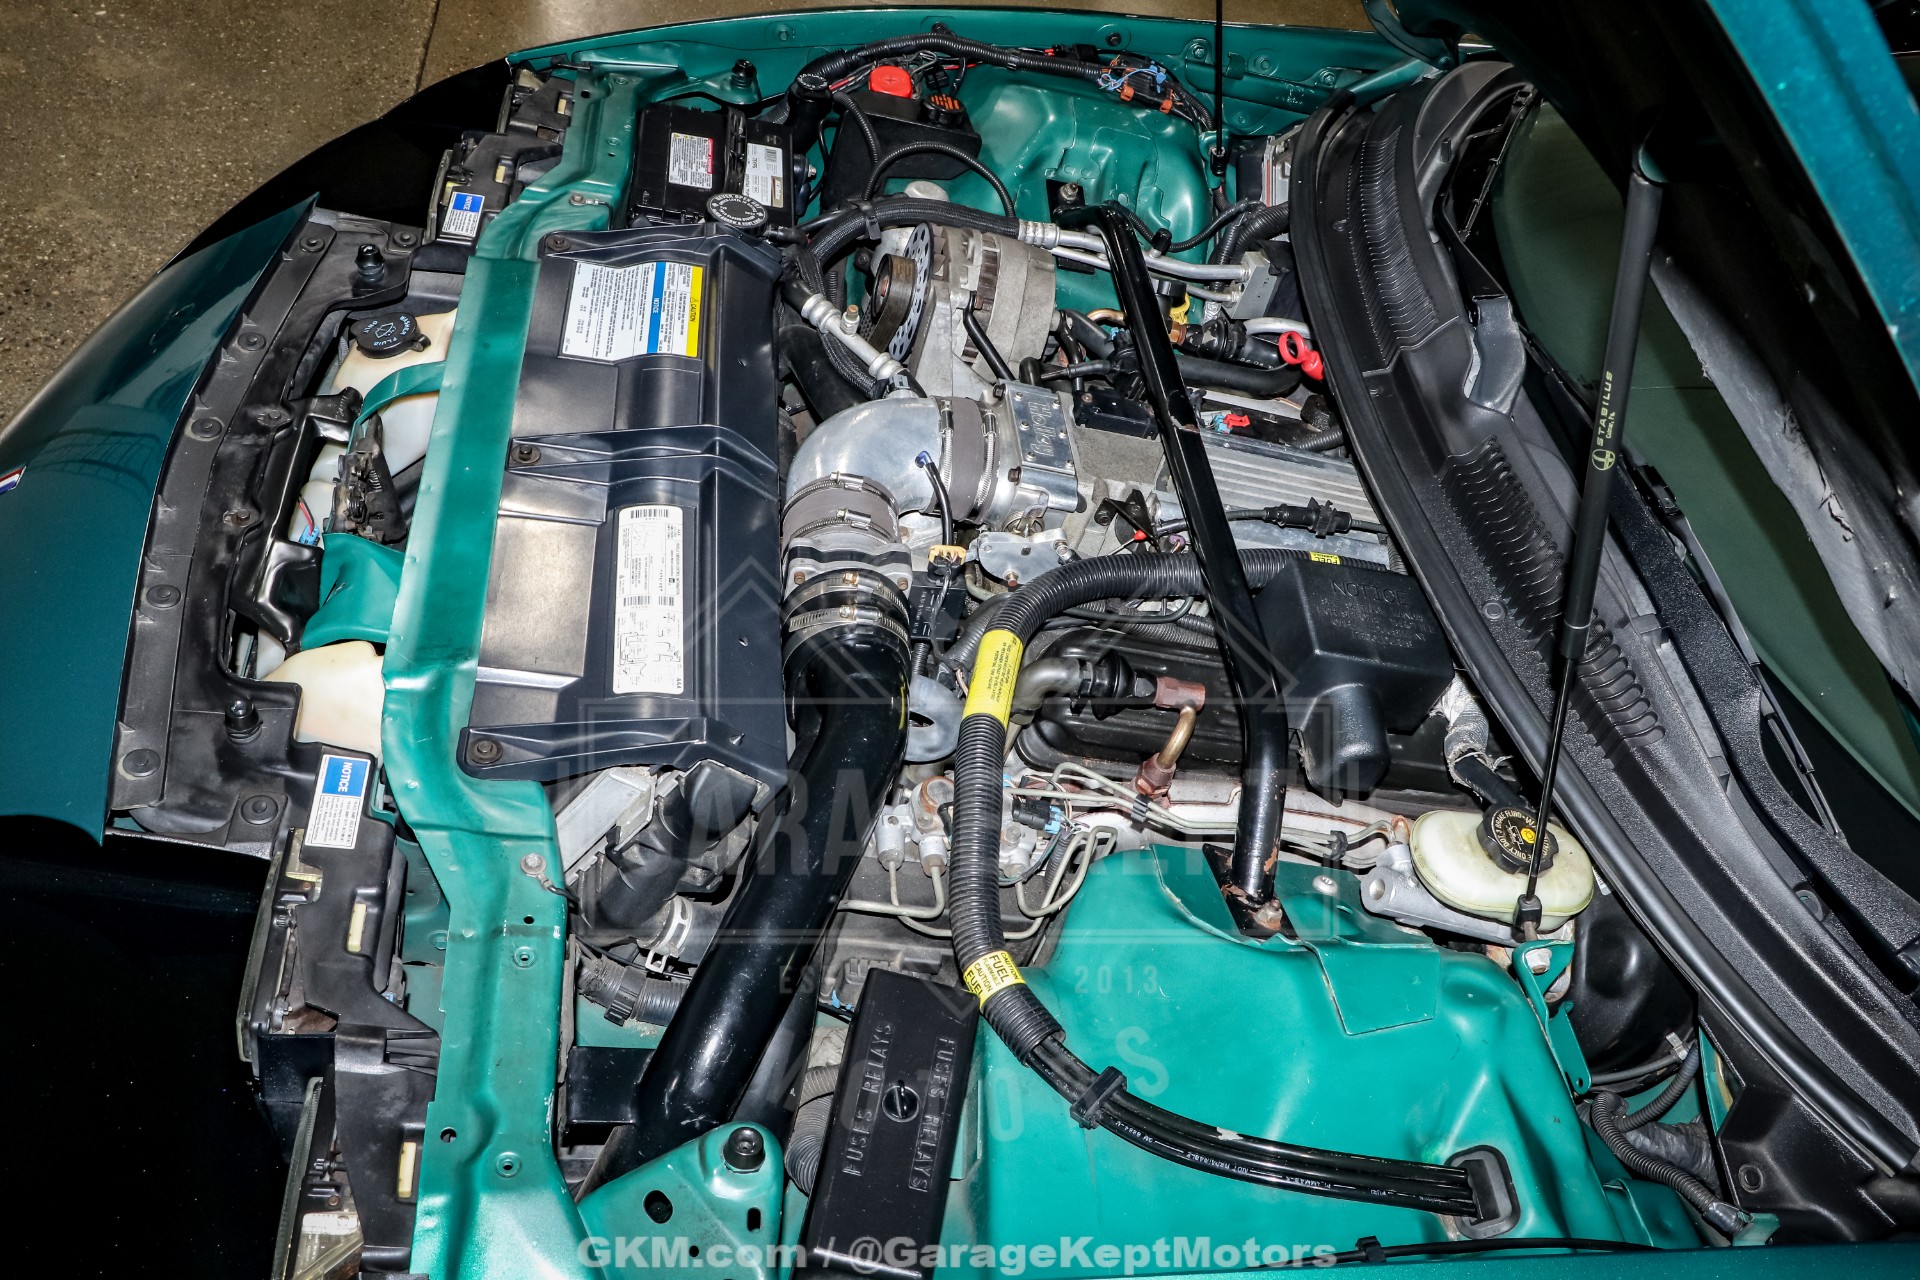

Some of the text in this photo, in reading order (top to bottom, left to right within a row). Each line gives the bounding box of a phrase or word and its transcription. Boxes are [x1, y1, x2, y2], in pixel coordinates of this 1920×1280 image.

[463, 195, 473, 210] NOTICE
[363, 315, 411, 346] WASHER FLUID ONLY
[1596, 371, 1613, 447] STABILUS
[1331, 580, 1408, 606] NOTICE
[337, 761, 353, 793] NOTICE
[1494, 811, 1507, 829] BRAKE
[1504, 810, 1522, 818] FLUID
[974, 962, 993, 992] CAUTION
[983, 958, 1001, 986] FLAMMABLE
[989, 954, 1010, 983] FUEL
[1001, 952, 1020, 980] CAUTION
[842, 1023, 892, 1177] FUSES RELAYS
[910, 1037, 956, 1190] FUSES RELAYS
[1186, 1151, 1249, 1175] NOT REPAIRABLE
